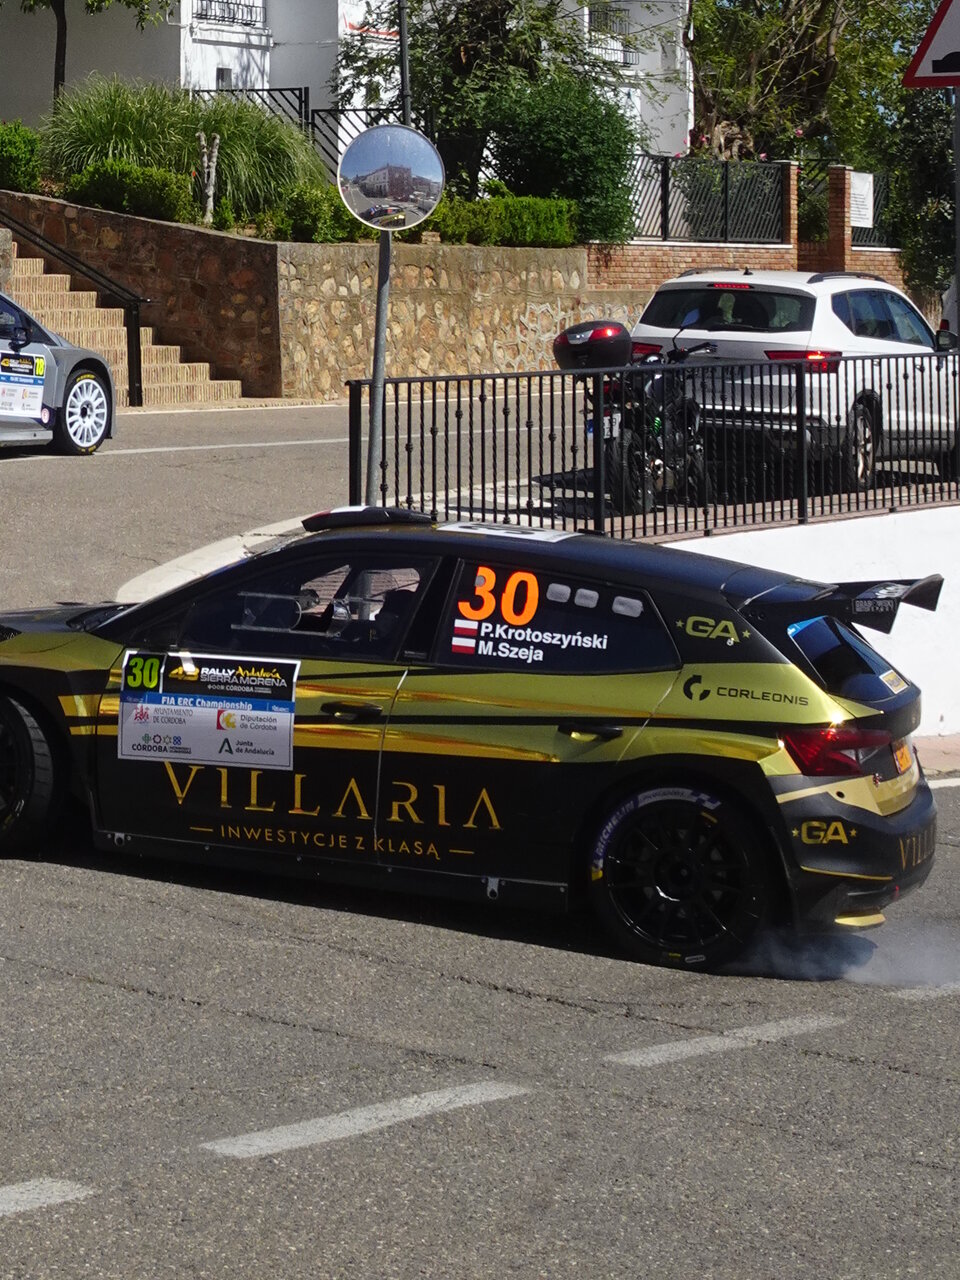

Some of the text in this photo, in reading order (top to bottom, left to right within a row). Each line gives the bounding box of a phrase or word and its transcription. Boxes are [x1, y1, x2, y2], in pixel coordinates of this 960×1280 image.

[35, 357, 44, 375] 18
[457, 565, 540, 626] 30
[480, 622, 608, 650] P.Krotoszyński
[685, 615, 741, 642] GA
[477, 640, 544, 664] M.Szeja
[127, 657, 160, 689] 30
[200, 667, 236, 677] RALLY
[161, 696, 253, 711] FIA ERC Championship
[716, 686, 809, 705] CORLEONIS
[153, 708, 194, 718] AYUNTAMIENTO
[240, 714, 277, 724] Diputación
[164, 761, 505, 831] VILLARIA
[595, 800, 634, 857] MICHELIN
[801, 820, 849, 844] GA
[220, 824, 441, 861] INWESTYCJE Z KLASĄ
